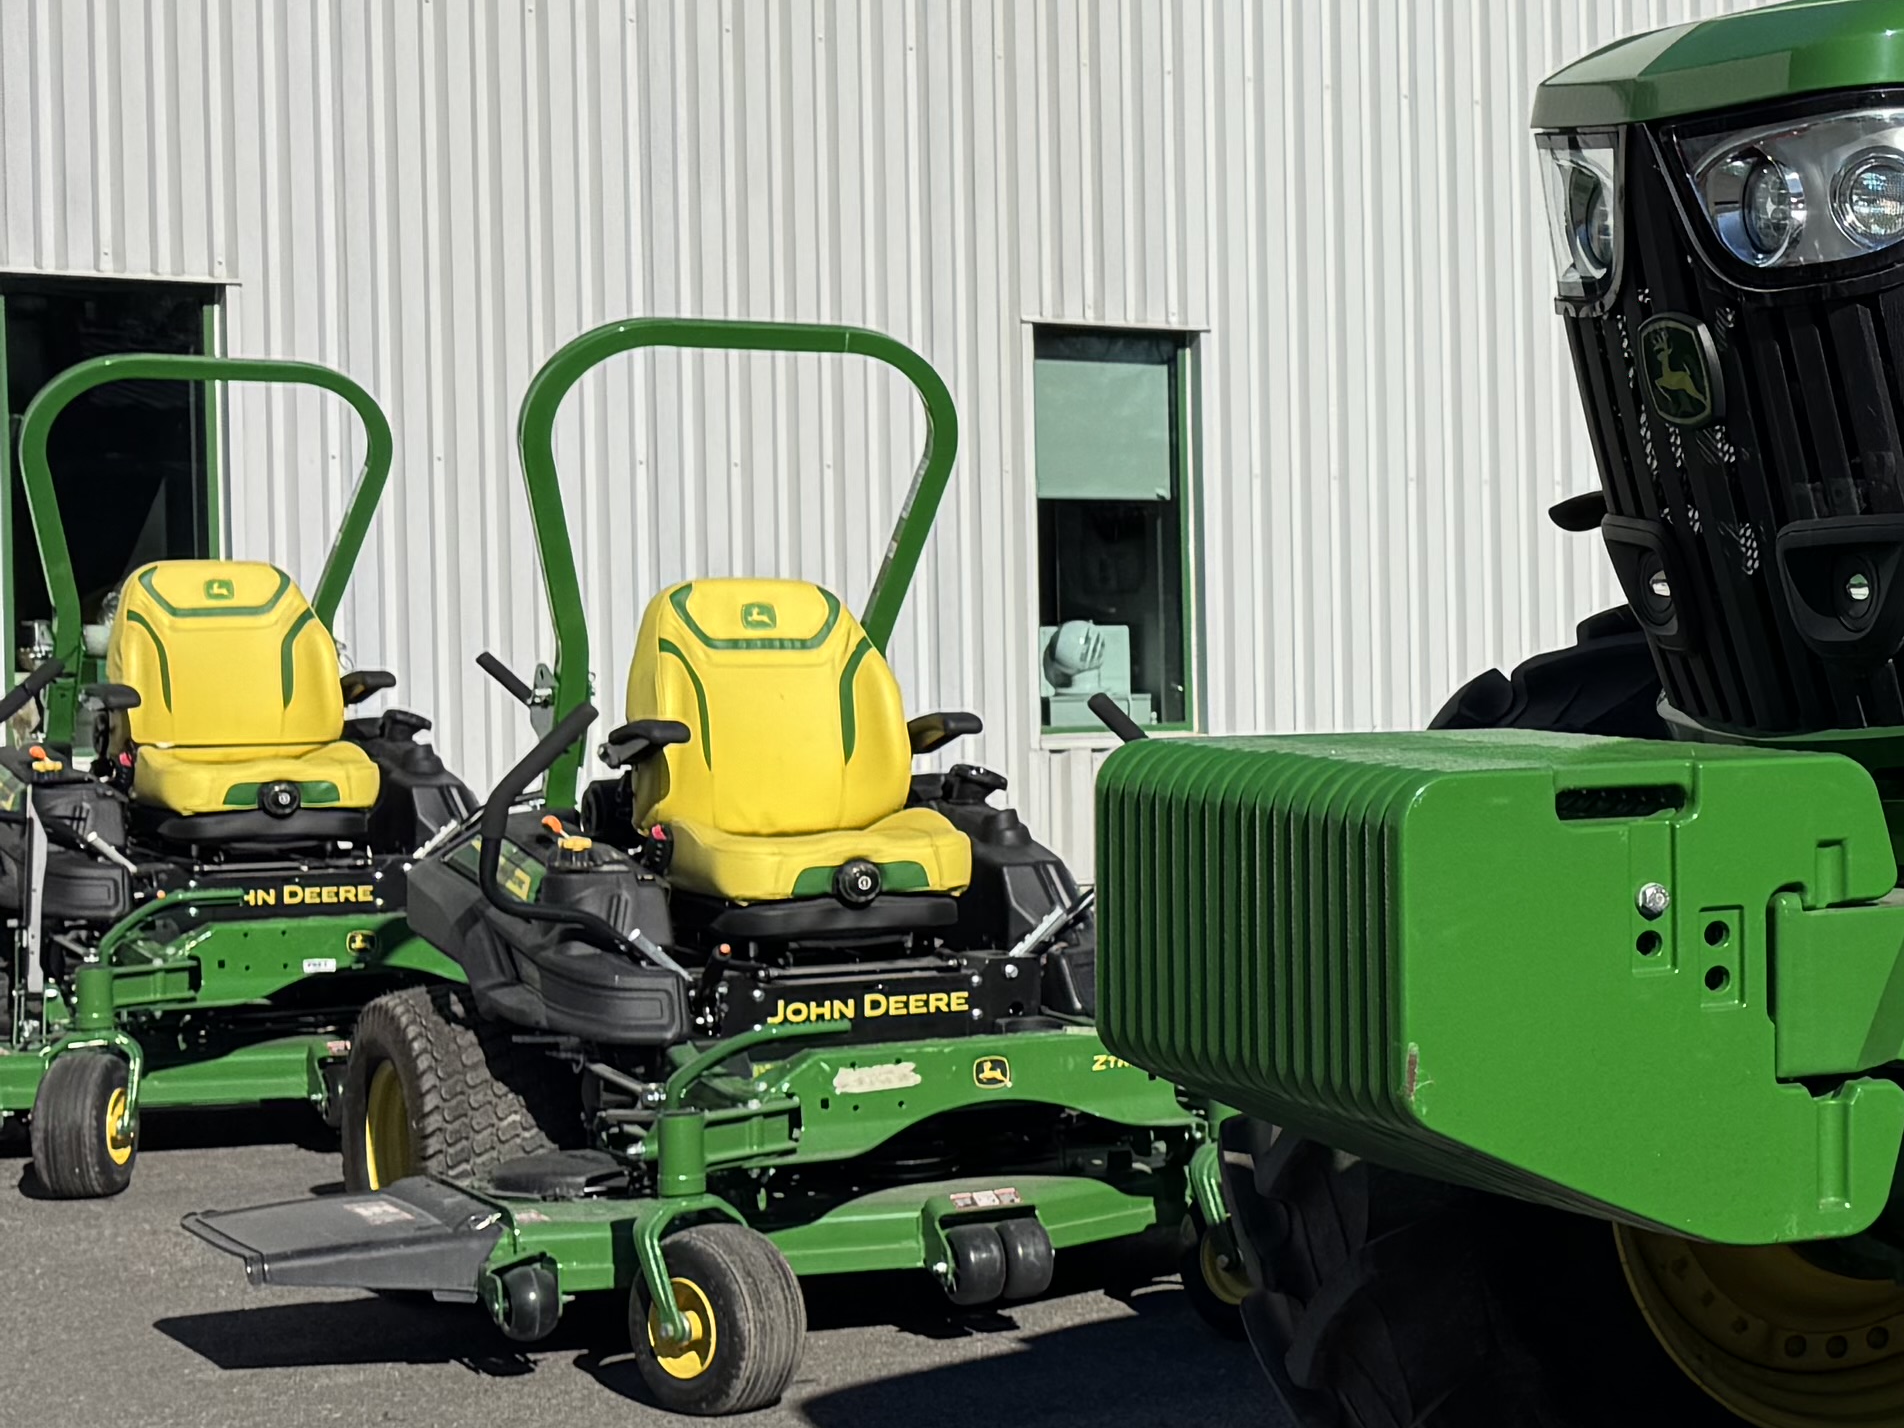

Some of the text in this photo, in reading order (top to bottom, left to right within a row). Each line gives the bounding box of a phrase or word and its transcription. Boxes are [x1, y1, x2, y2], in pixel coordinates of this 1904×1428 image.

[244, 885, 374, 907] HN DEERE
[767, 991, 969, 1024] JOHN DEERE
